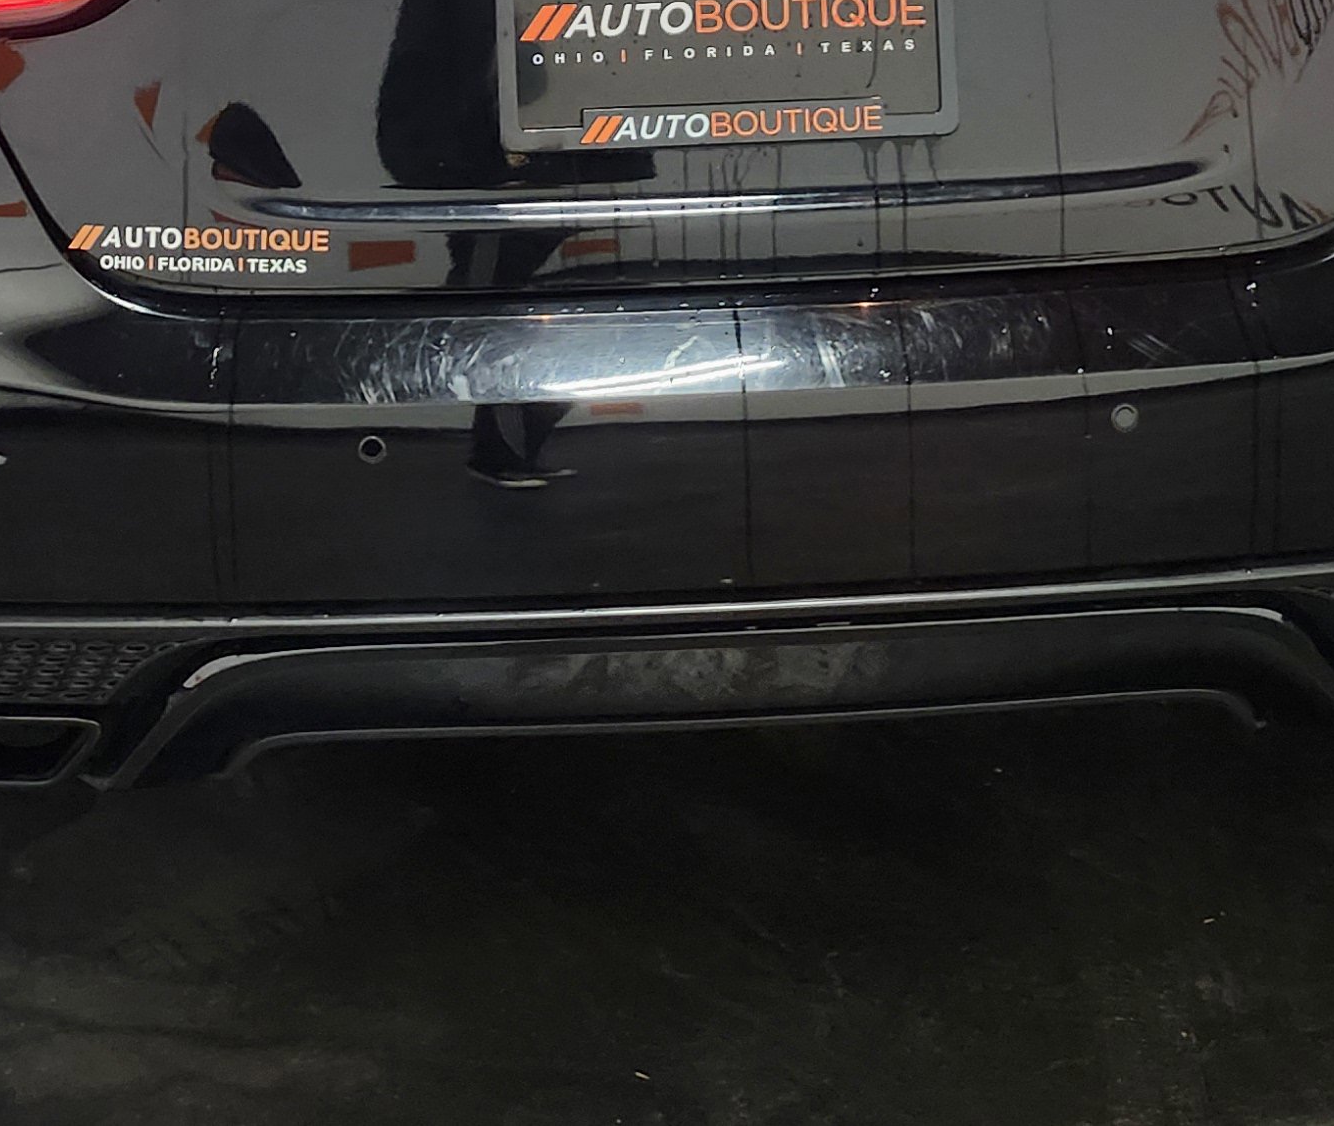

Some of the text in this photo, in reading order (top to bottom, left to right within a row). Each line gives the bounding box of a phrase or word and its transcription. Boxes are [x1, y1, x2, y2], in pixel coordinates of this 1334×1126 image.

[531, 38, 916, 66] OHIO FLORIDA TEXAS
[612, 104, 884, 143] AUTOBOUTIQUE
[100, 225, 331, 252] AUTOBOUTIQUE
[99, 254, 308, 274] OHIO FLORIDA TEXAS
